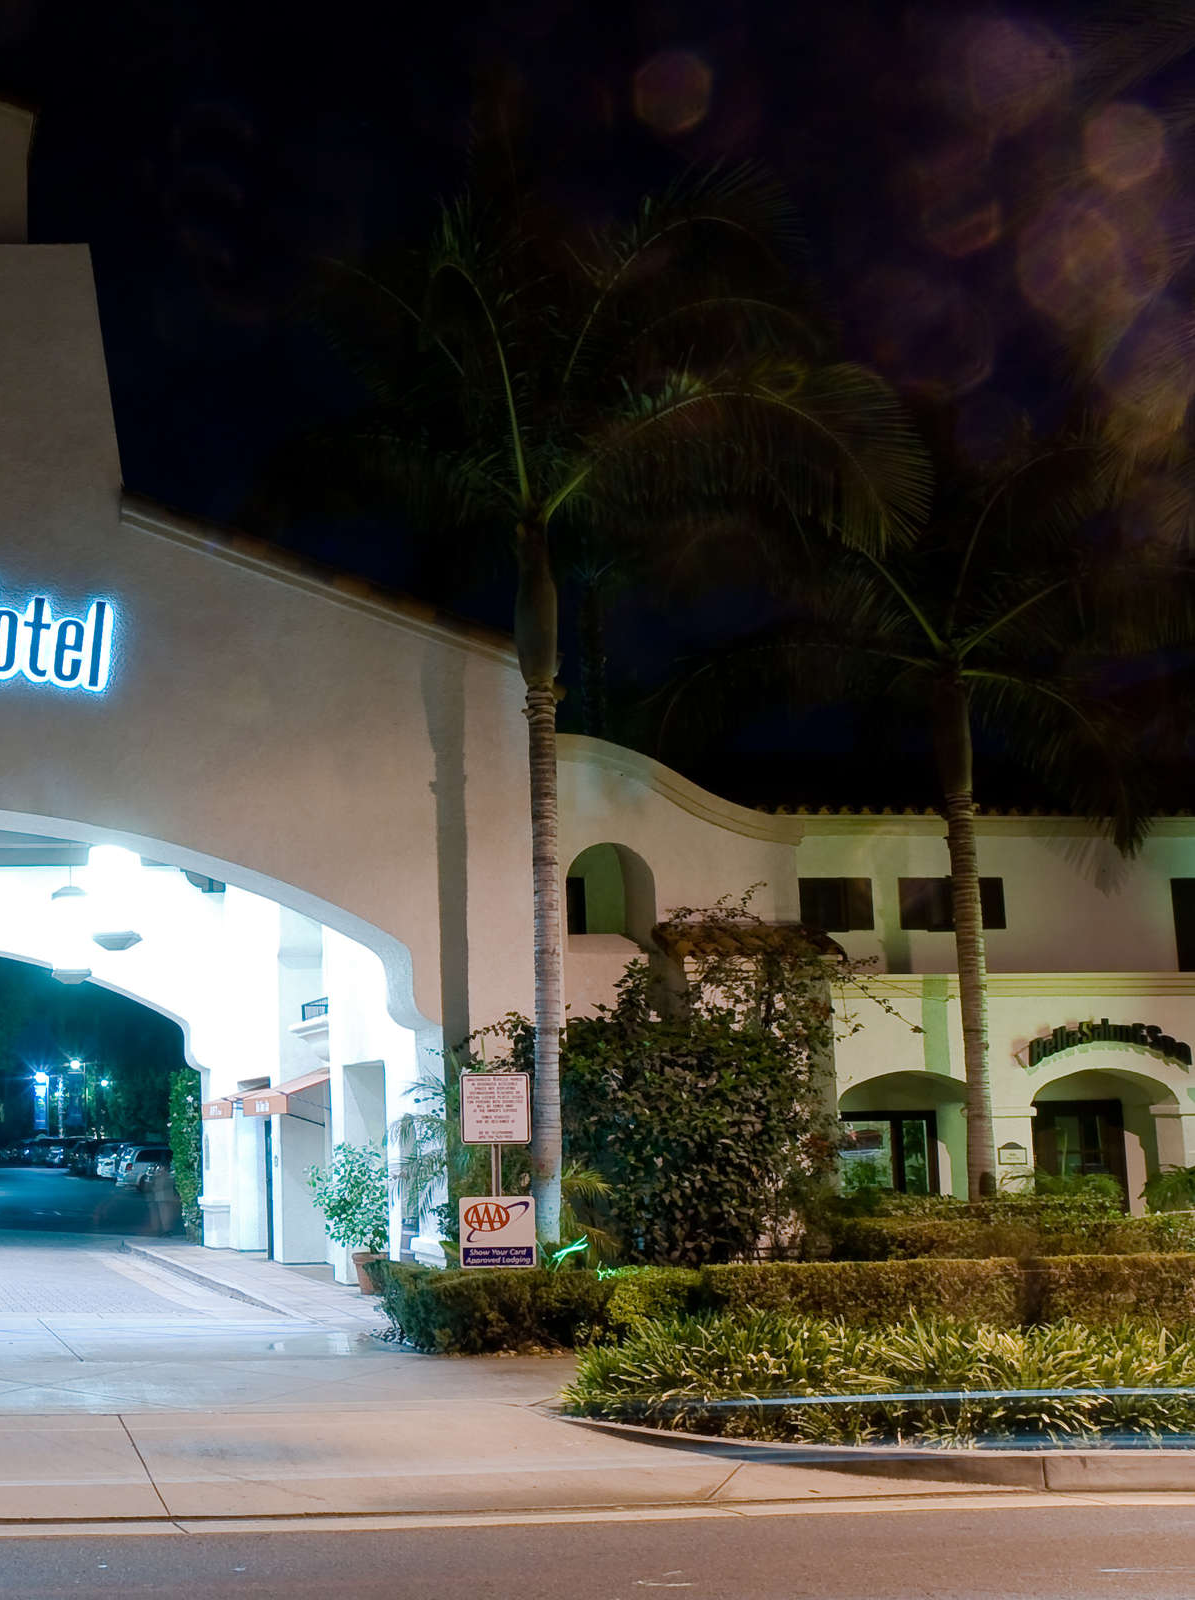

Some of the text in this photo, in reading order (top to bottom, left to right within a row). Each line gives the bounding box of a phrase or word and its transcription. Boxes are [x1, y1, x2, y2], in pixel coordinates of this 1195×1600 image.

[466, 1203, 508, 1231] AAA
[466, 1256, 531, 1264] Approved Lodging
